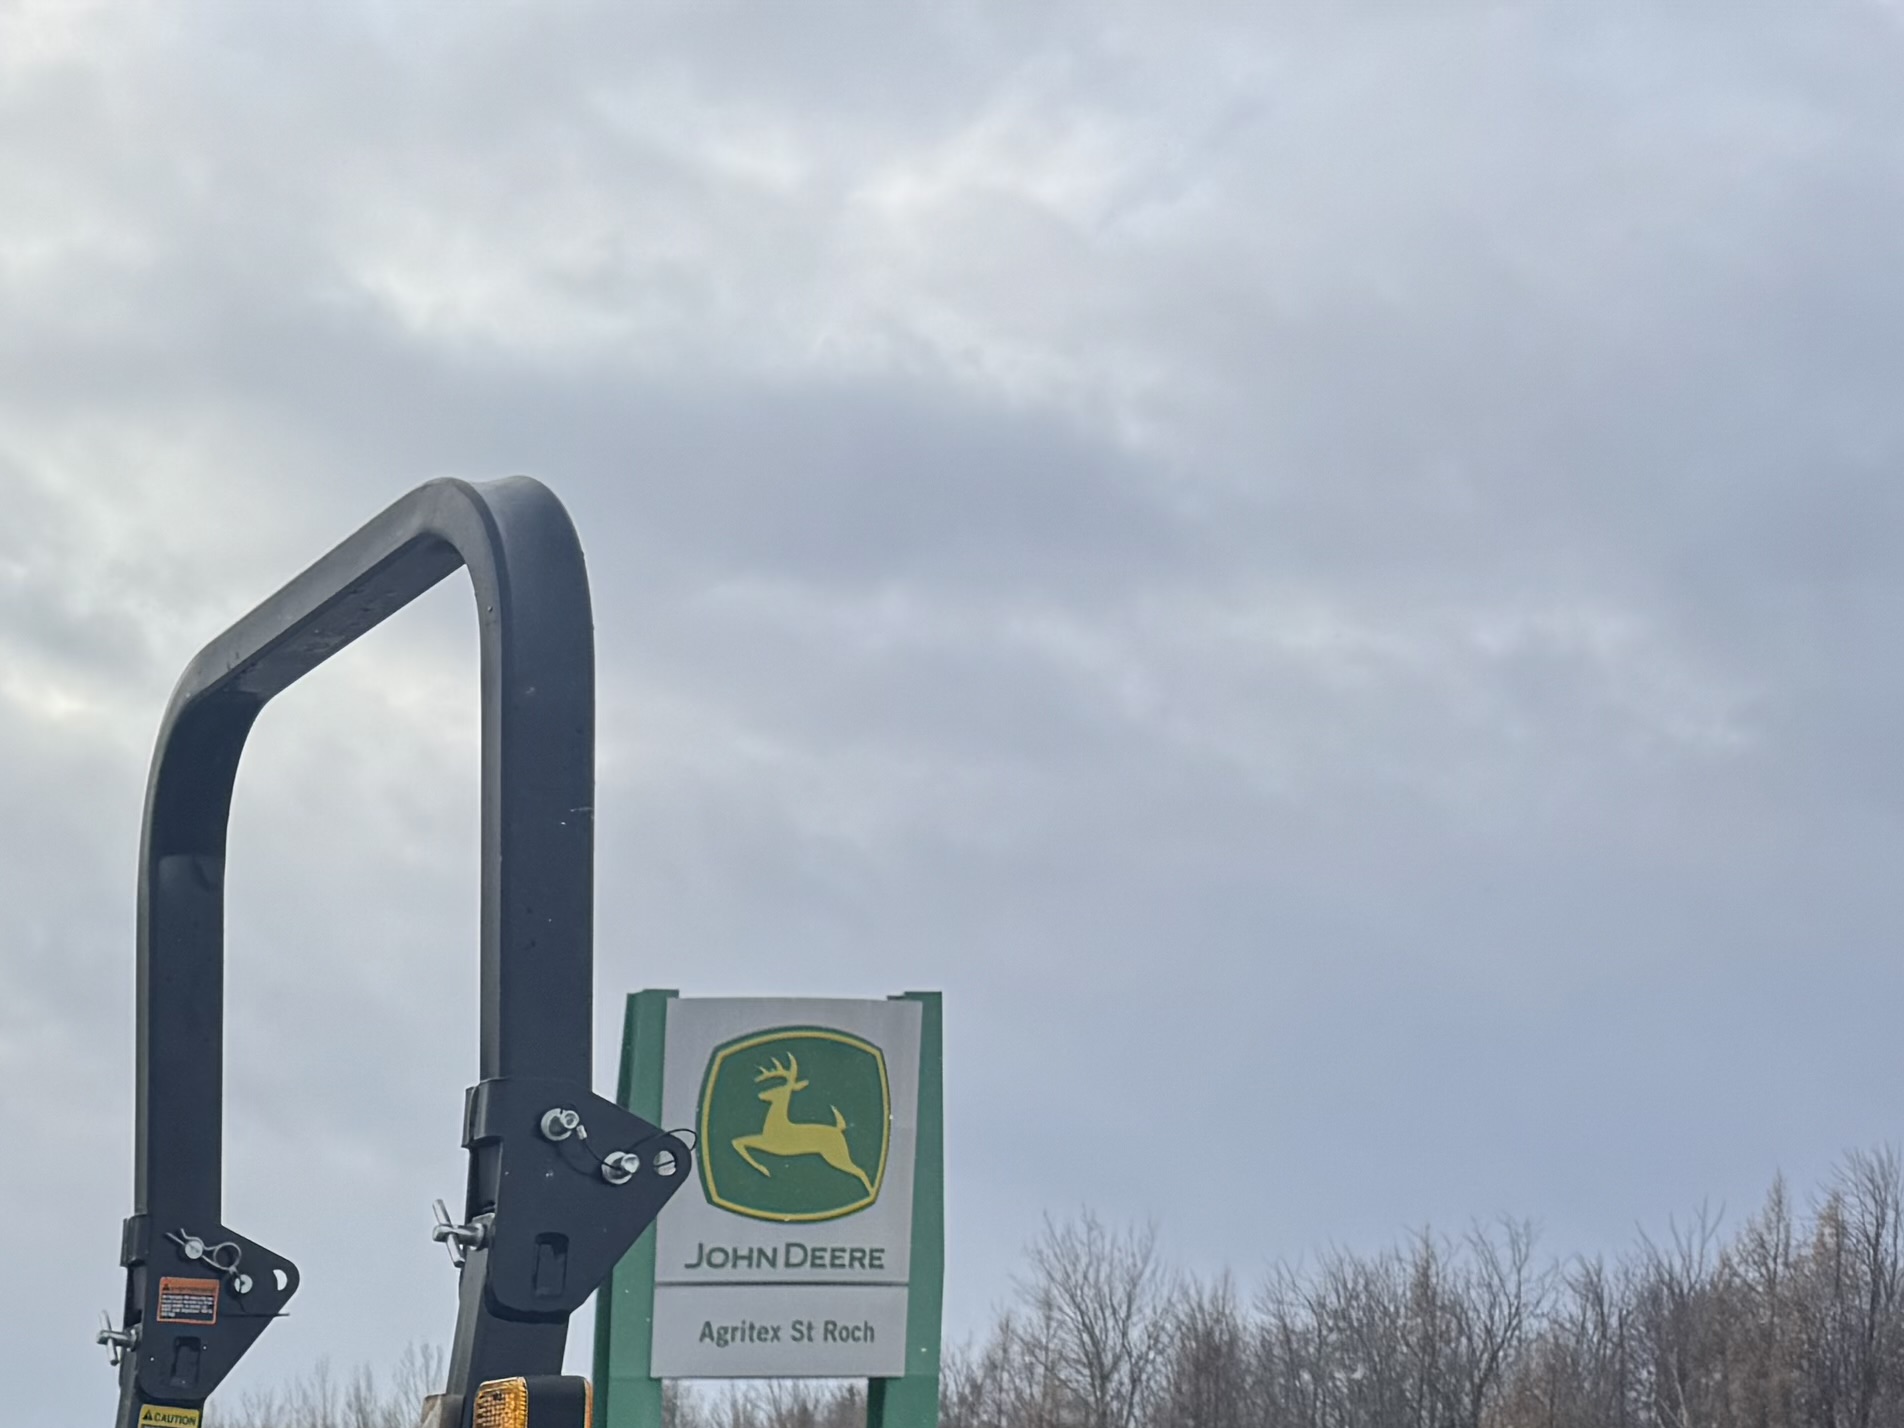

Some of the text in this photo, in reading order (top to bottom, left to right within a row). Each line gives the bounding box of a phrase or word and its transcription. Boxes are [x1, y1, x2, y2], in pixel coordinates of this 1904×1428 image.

[684, 1242, 886, 1270] JOHN DEERE
[699, 1320, 875, 1346] Agritex St Roch
[154, 1411, 197, 1426] CAUTION
